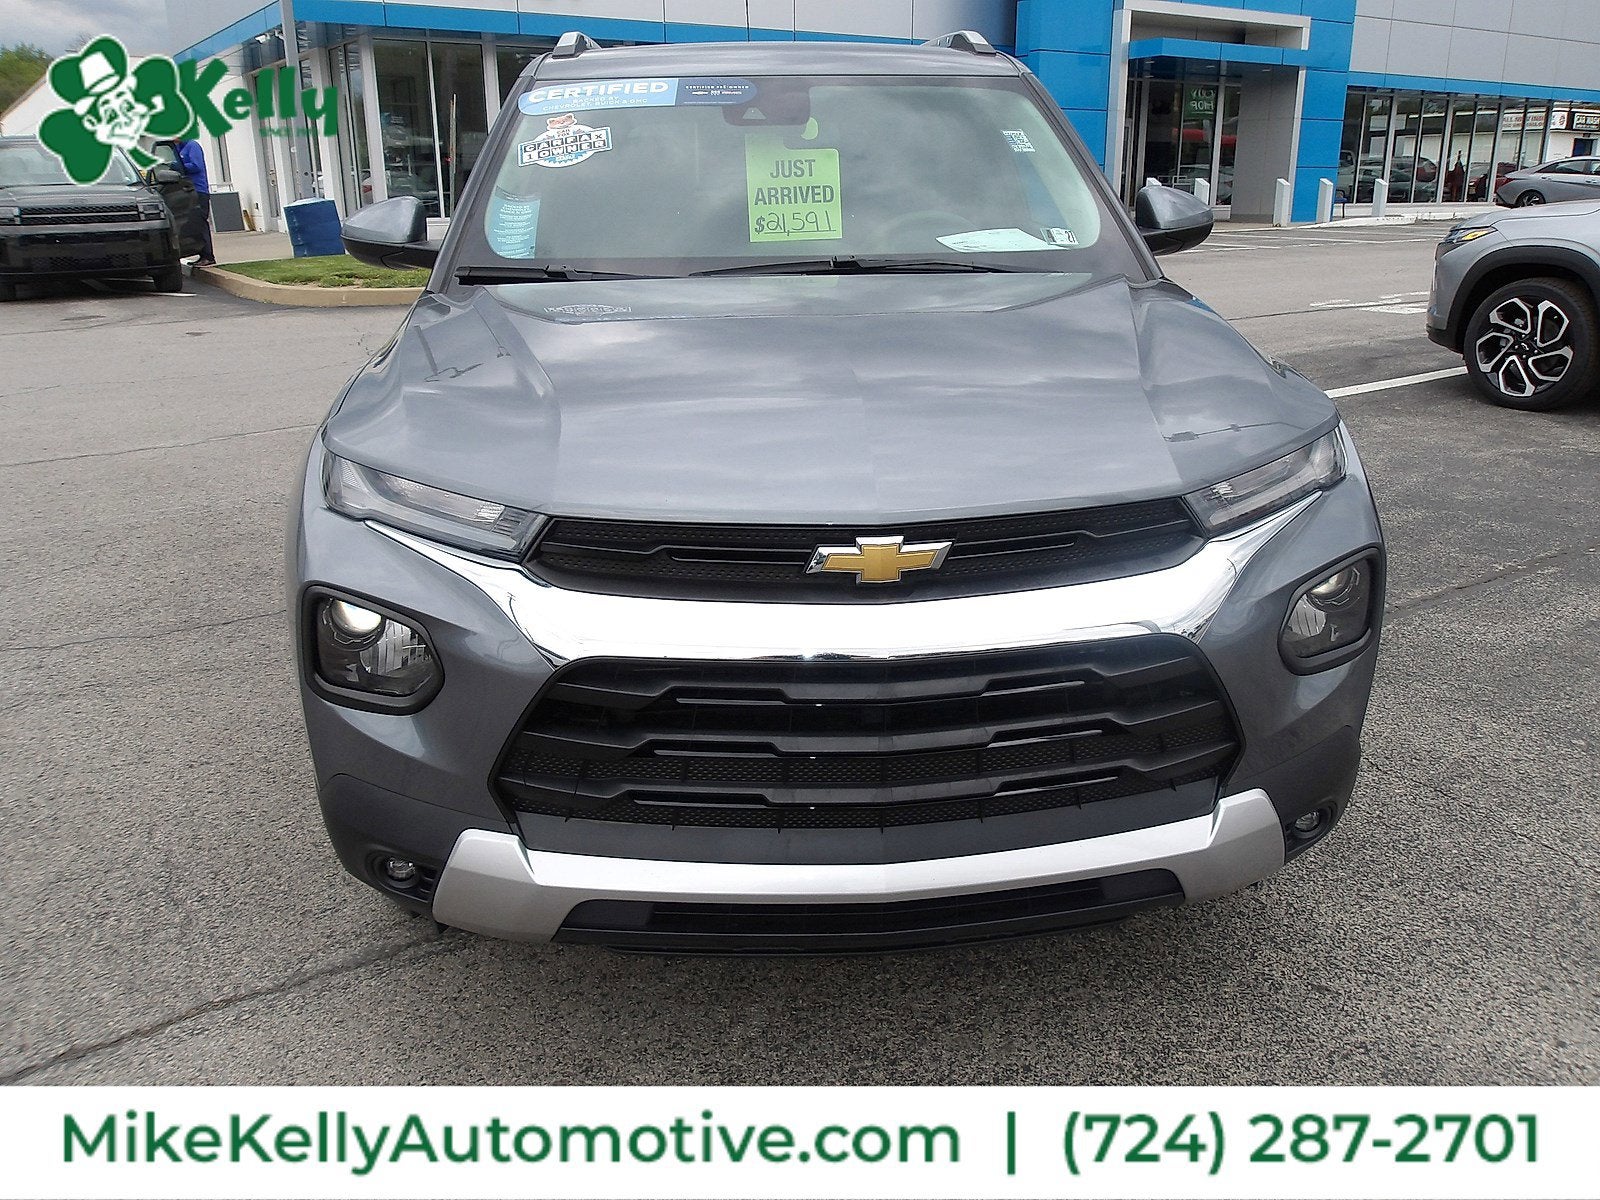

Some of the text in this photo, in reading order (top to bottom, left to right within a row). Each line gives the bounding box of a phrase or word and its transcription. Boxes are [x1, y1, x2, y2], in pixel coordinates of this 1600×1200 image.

[527, 80, 670, 104] CERTIFIED
[524, 133, 603, 153] CARFAX
[538, 139, 607, 158] OWNER
[770, 159, 816, 178] JUST
[754, 185, 835, 206] ARRIVED
[754, 210, 834, 236] $21,591
